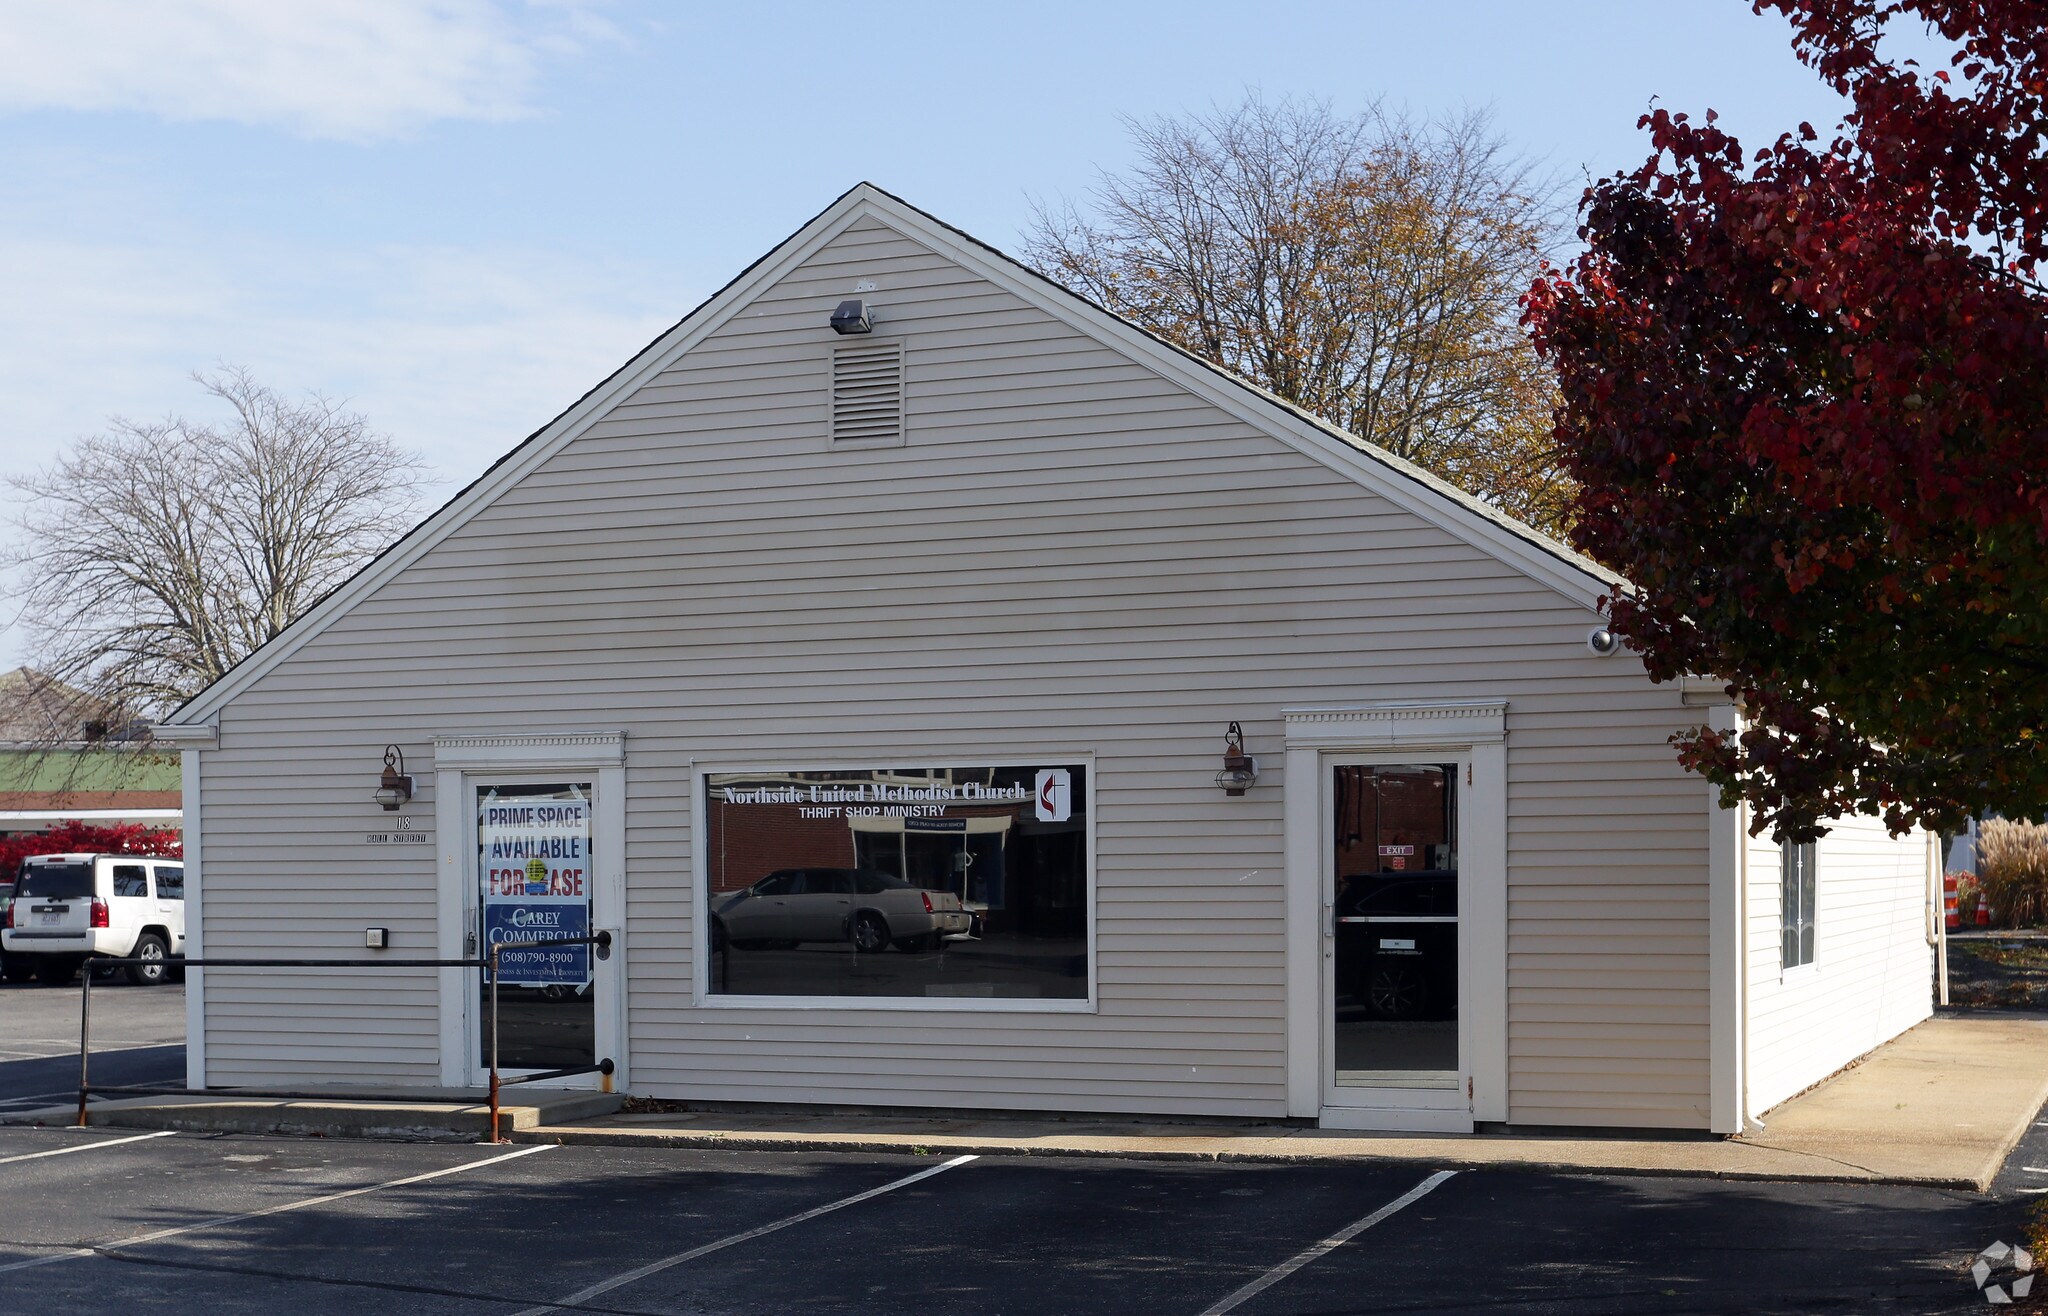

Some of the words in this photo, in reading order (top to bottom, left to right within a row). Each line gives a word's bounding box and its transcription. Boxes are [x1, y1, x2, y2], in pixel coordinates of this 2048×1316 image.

[723, 786, 805, 804] Northside
[810, 784, 864, 803] United
[870, 783, 957, 801] Methodist
[962, 781, 1026, 800] Church
[489, 807, 534, 828] PRIME
[537, 807, 582, 828] SPACE
[799, 807, 842, 818] THRIFT
[845, 806, 880, 818] SHOP
[883, 804, 946, 817] MINISTRY
[397, 816, 411, 829] 18
[394, 834, 426, 842] STREET
[491, 835, 580, 858] AVAILABLE
[490, 868, 525, 896] FOR
[512, 908, 560, 928] CAREY
[501, 952, 574, 963] (508)790-8900
